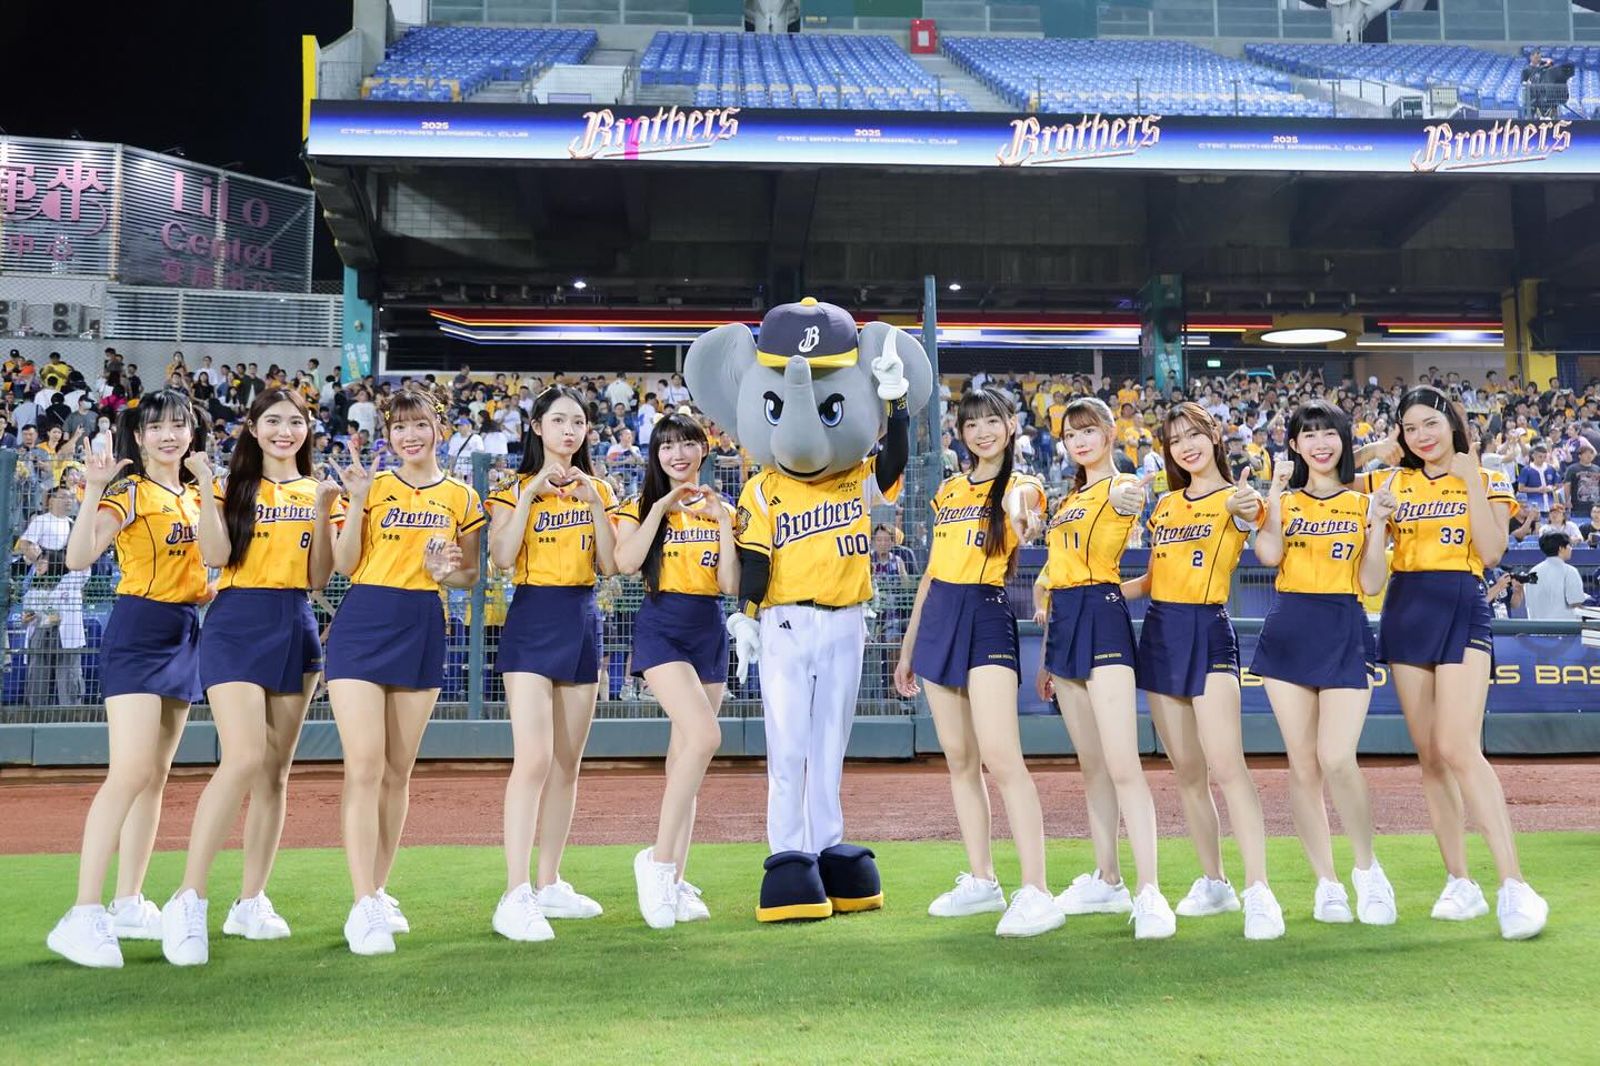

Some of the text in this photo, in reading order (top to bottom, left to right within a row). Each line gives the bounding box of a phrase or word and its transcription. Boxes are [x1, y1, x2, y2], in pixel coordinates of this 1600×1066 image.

[421, 121, 449, 130] 2025
[567, 106, 740, 159] Brothers
[854, 129, 881, 137] 2025
[996, 113, 1162, 166] Brothers
[1272, 135, 1299, 143] 2025
[1411, 118, 1572, 172] Brothers
[380, 507, 451, 528] Brothers
[1394, 500, 1468, 523] Brothers
[773, 496, 863, 549] Brothers
[1284, 517, 1359, 537] Brothers
[300, 531, 311, 549] 8
[836, 533, 869, 557] 100
[966, 529, 987, 548] 18
[1064, 532, 1080, 549] 11
[1440, 527, 1466, 545] 33
[700, 550, 720, 568] 29
[1192, 550, 1204, 567] 2
[1331, 542, 1355, 561] 27
